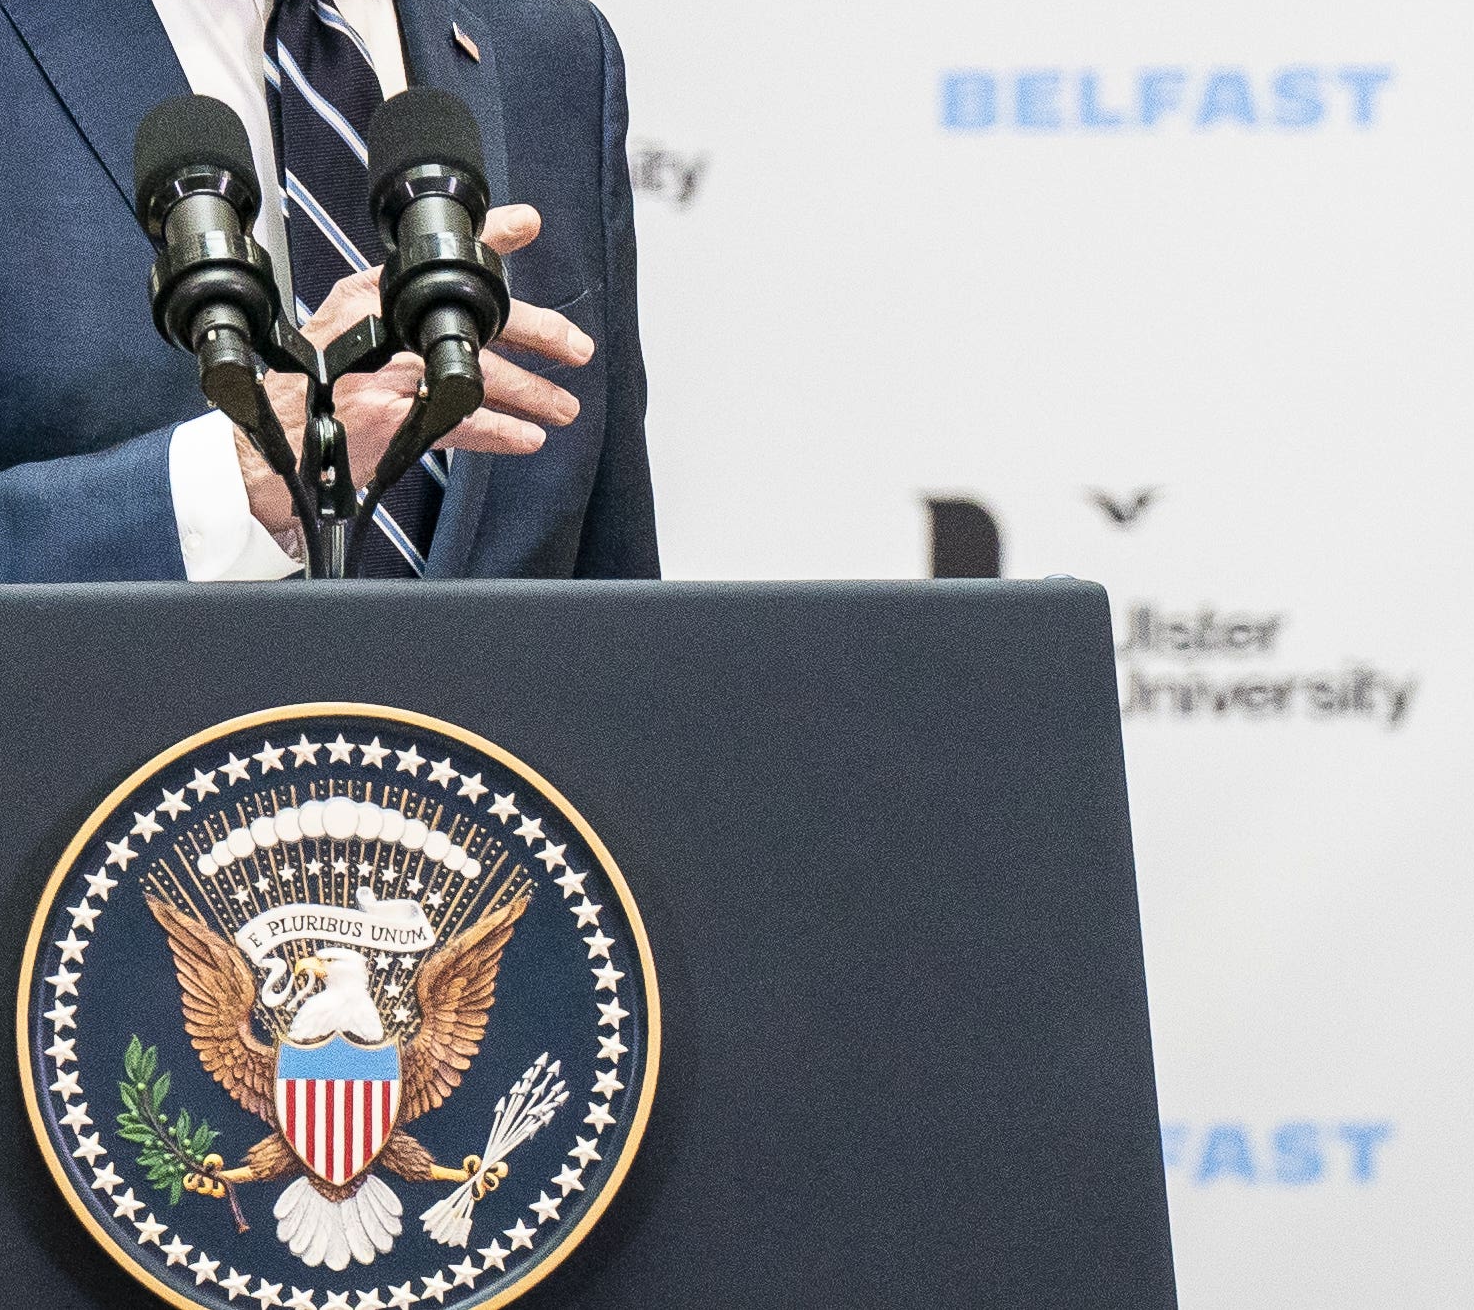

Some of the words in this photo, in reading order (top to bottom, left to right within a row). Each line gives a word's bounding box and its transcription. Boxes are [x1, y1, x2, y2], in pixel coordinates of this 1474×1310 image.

[937, 65, 1391, 133] BELFAST
[246, 931, 263, 949] E
[265, 914, 364, 939] PLURIBUS
[370, 924, 428, 945] UNUM
